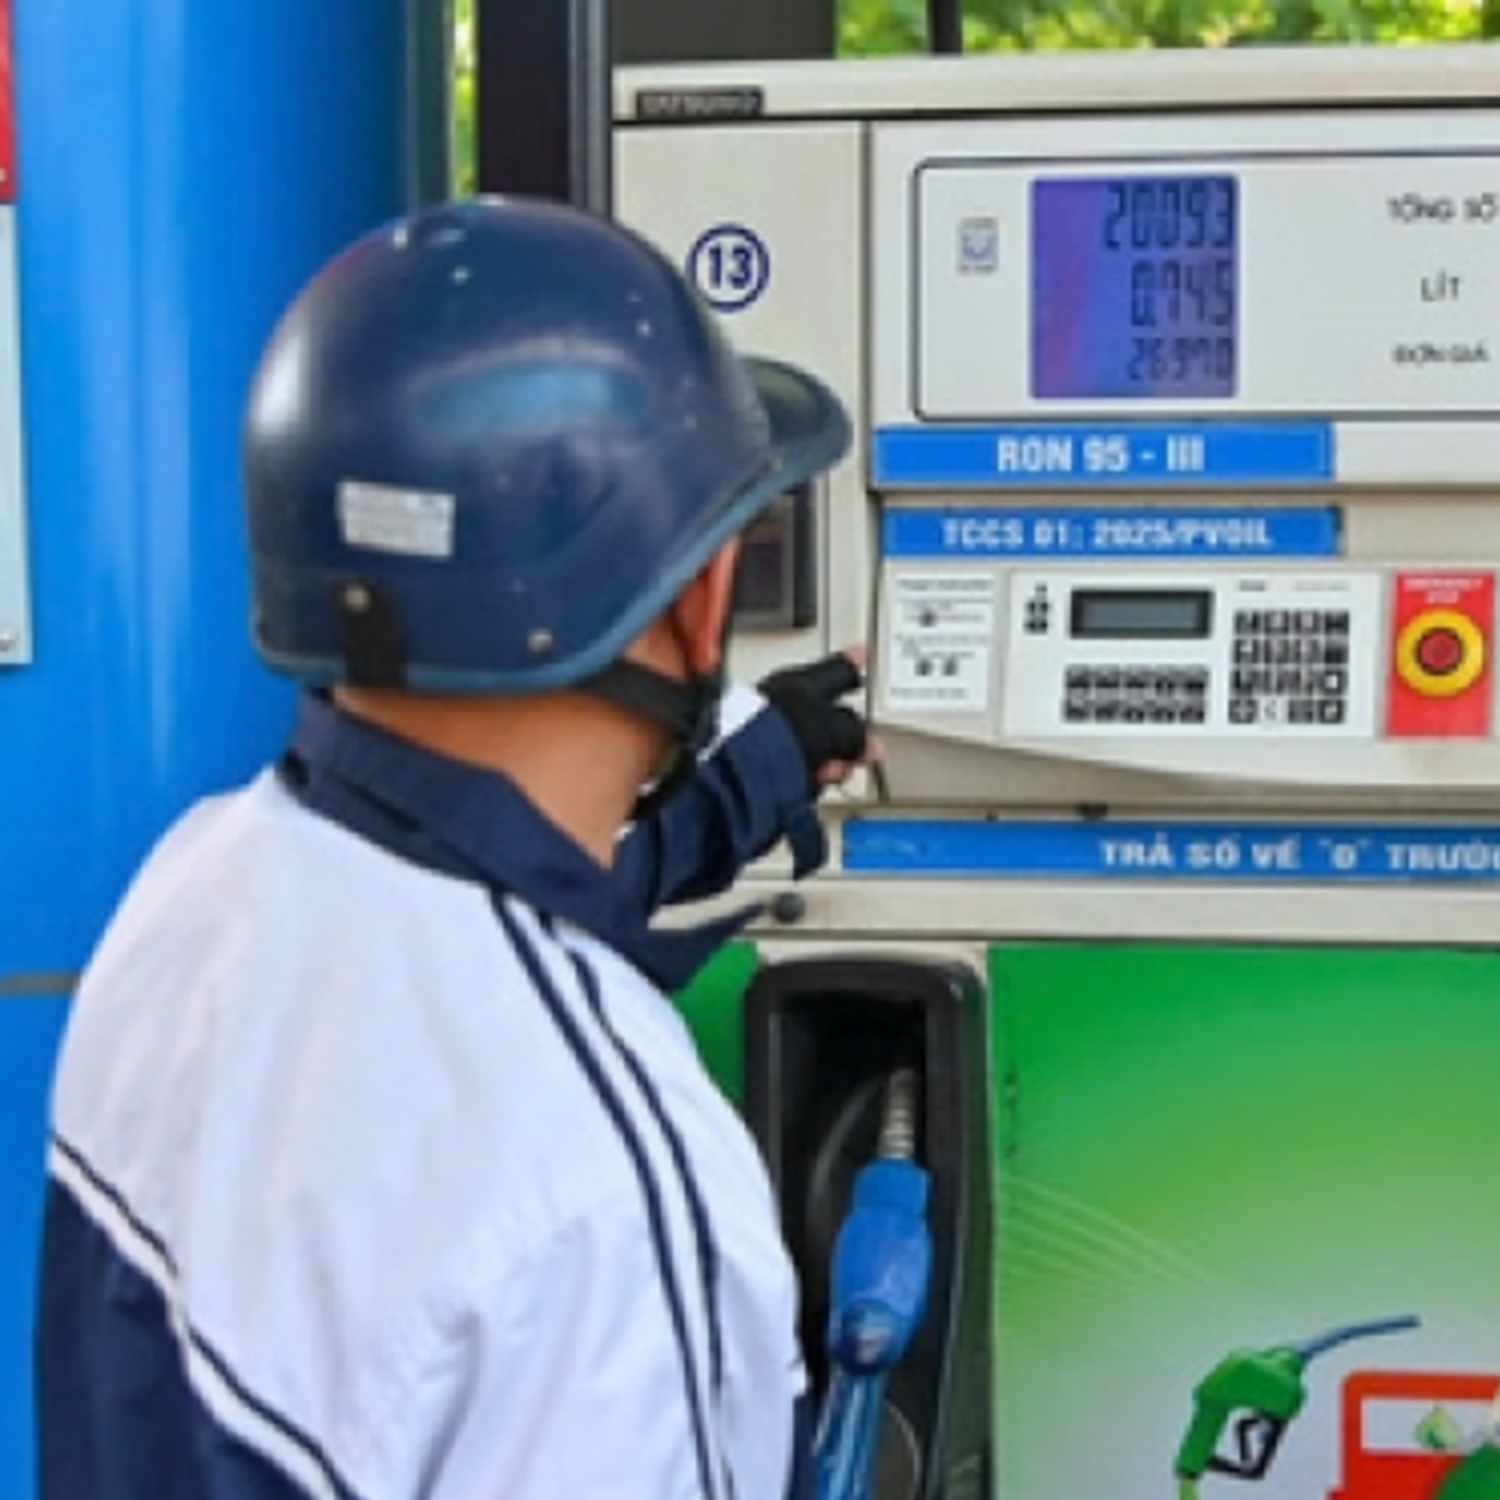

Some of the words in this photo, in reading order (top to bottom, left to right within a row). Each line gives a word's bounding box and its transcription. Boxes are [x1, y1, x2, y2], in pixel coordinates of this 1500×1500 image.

[706, 244, 755, 289] 13
[997, 436, 1073, 471] RON
[1084, 435, 1130, 471] 95
[1167, 435, 1204, 470] III
[943, 518, 1024, 548] TCCS
[1102, 838, 1174, 868] TRẢ
